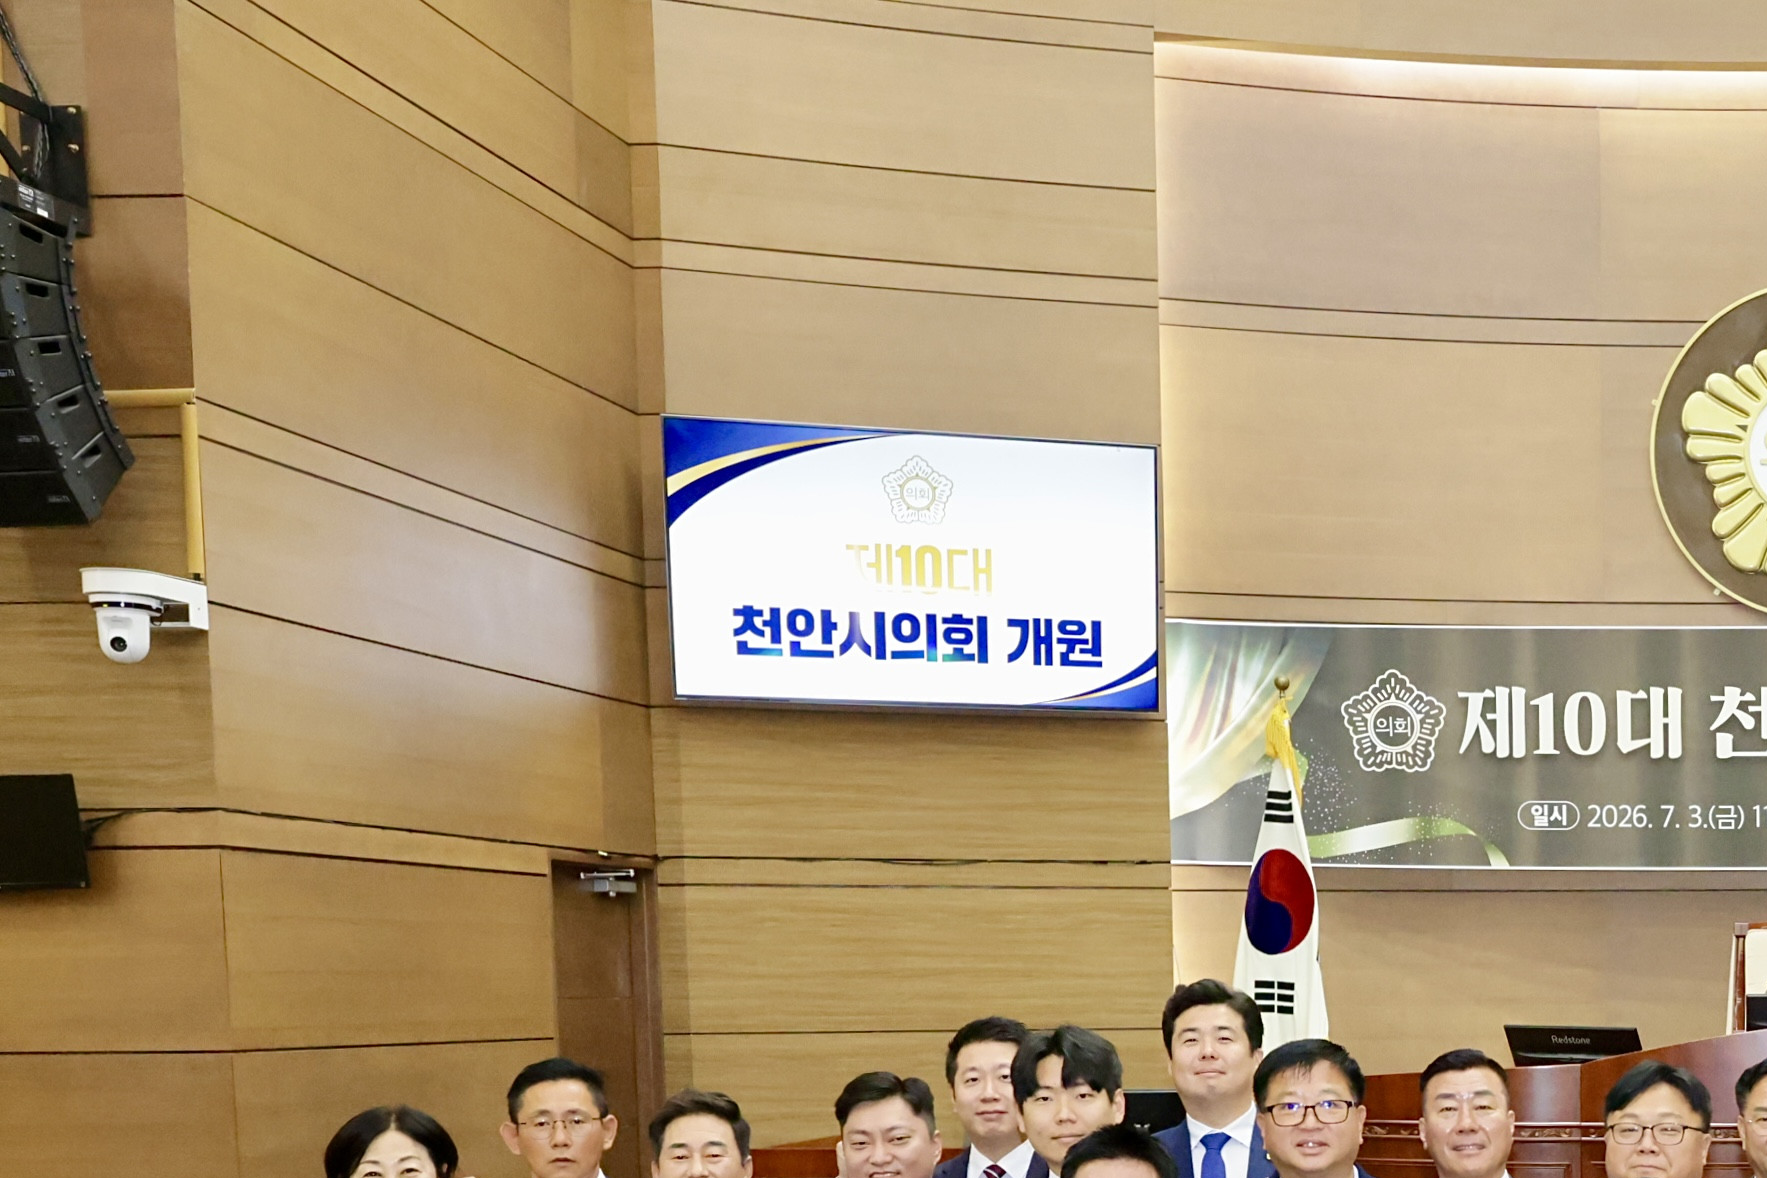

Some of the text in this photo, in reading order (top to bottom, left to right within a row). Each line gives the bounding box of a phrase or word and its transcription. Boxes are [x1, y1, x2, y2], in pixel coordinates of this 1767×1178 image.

[905, 487, 931, 501] 의회
[846, 543, 993, 597] 제10대
[733, 605, 1103, 668] 천안시의회 개원
[1375, 716, 1412, 738] 의회
[1457, 686, 1683, 759] 제10대
[1531, 804, 1569, 828] 일시
[1587, 804, 1653, 829] 2026.
[1660, 804, 1680, 829] 7.
[1688, 803, 1745, 831] 3.(금)
[1551, 1034, 1591, 1045] Redstone
